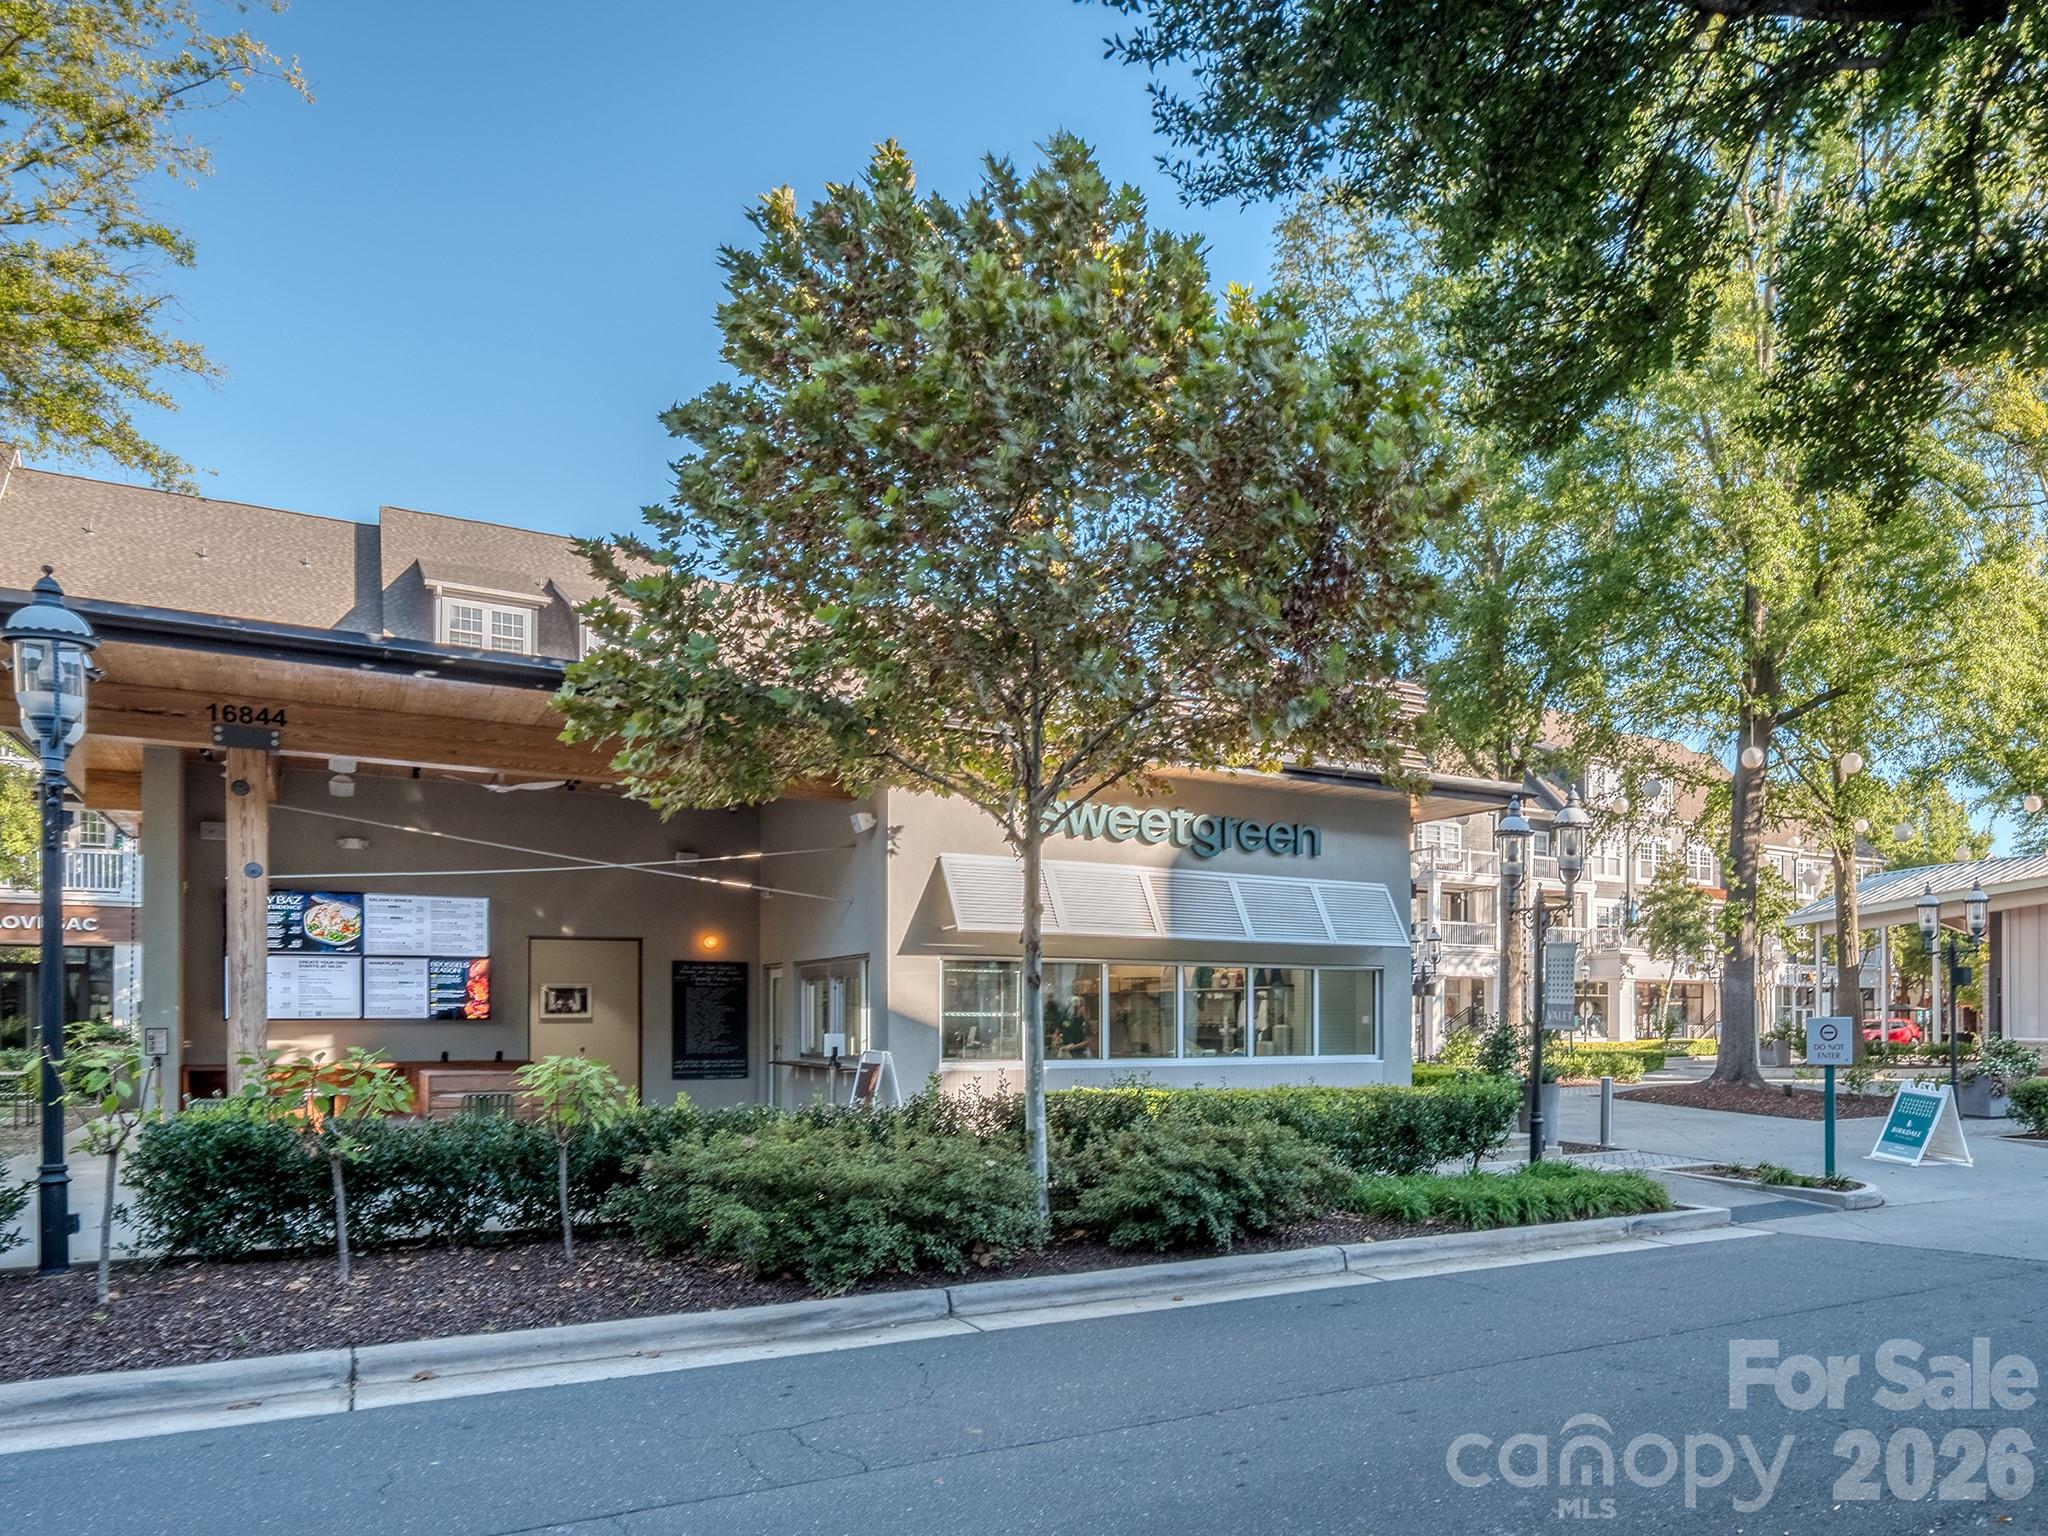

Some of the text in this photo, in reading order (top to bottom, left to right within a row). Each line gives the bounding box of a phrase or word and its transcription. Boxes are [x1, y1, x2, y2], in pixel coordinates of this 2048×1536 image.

[205, 703, 288, 727] 16844
[1040, 800, 1321, 858] sweetgreen
[0, 915, 98, 931] OVAC
[1547, 1010, 1572, 1021] VALET
[1813, 1043, 1845, 1051] DO NOT
[1817, 1051, 1841, 1060] ENTER
